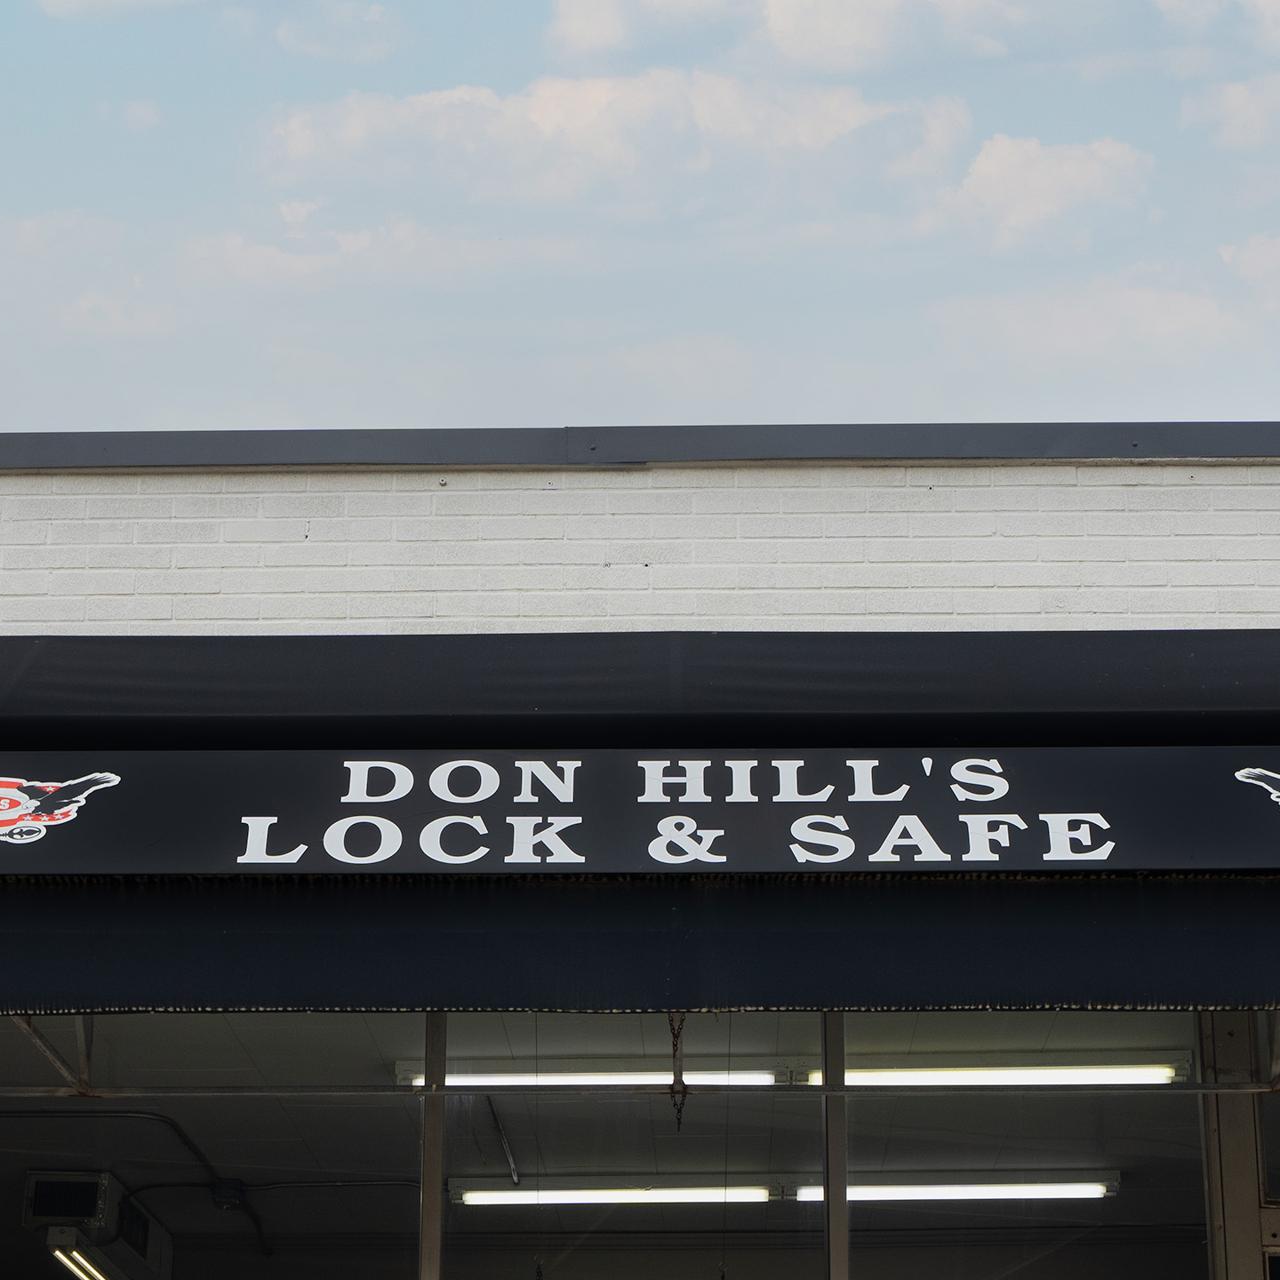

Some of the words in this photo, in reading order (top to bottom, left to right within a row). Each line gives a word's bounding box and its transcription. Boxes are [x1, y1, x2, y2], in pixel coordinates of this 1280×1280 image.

[340, 759, 582, 804] DON
[637, 757, 1010, 803] HILL'S
[236, 815, 586, 865] LOCK
[647, 815, 727, 864] &
[788, 812, 1116, 864] SAFE
